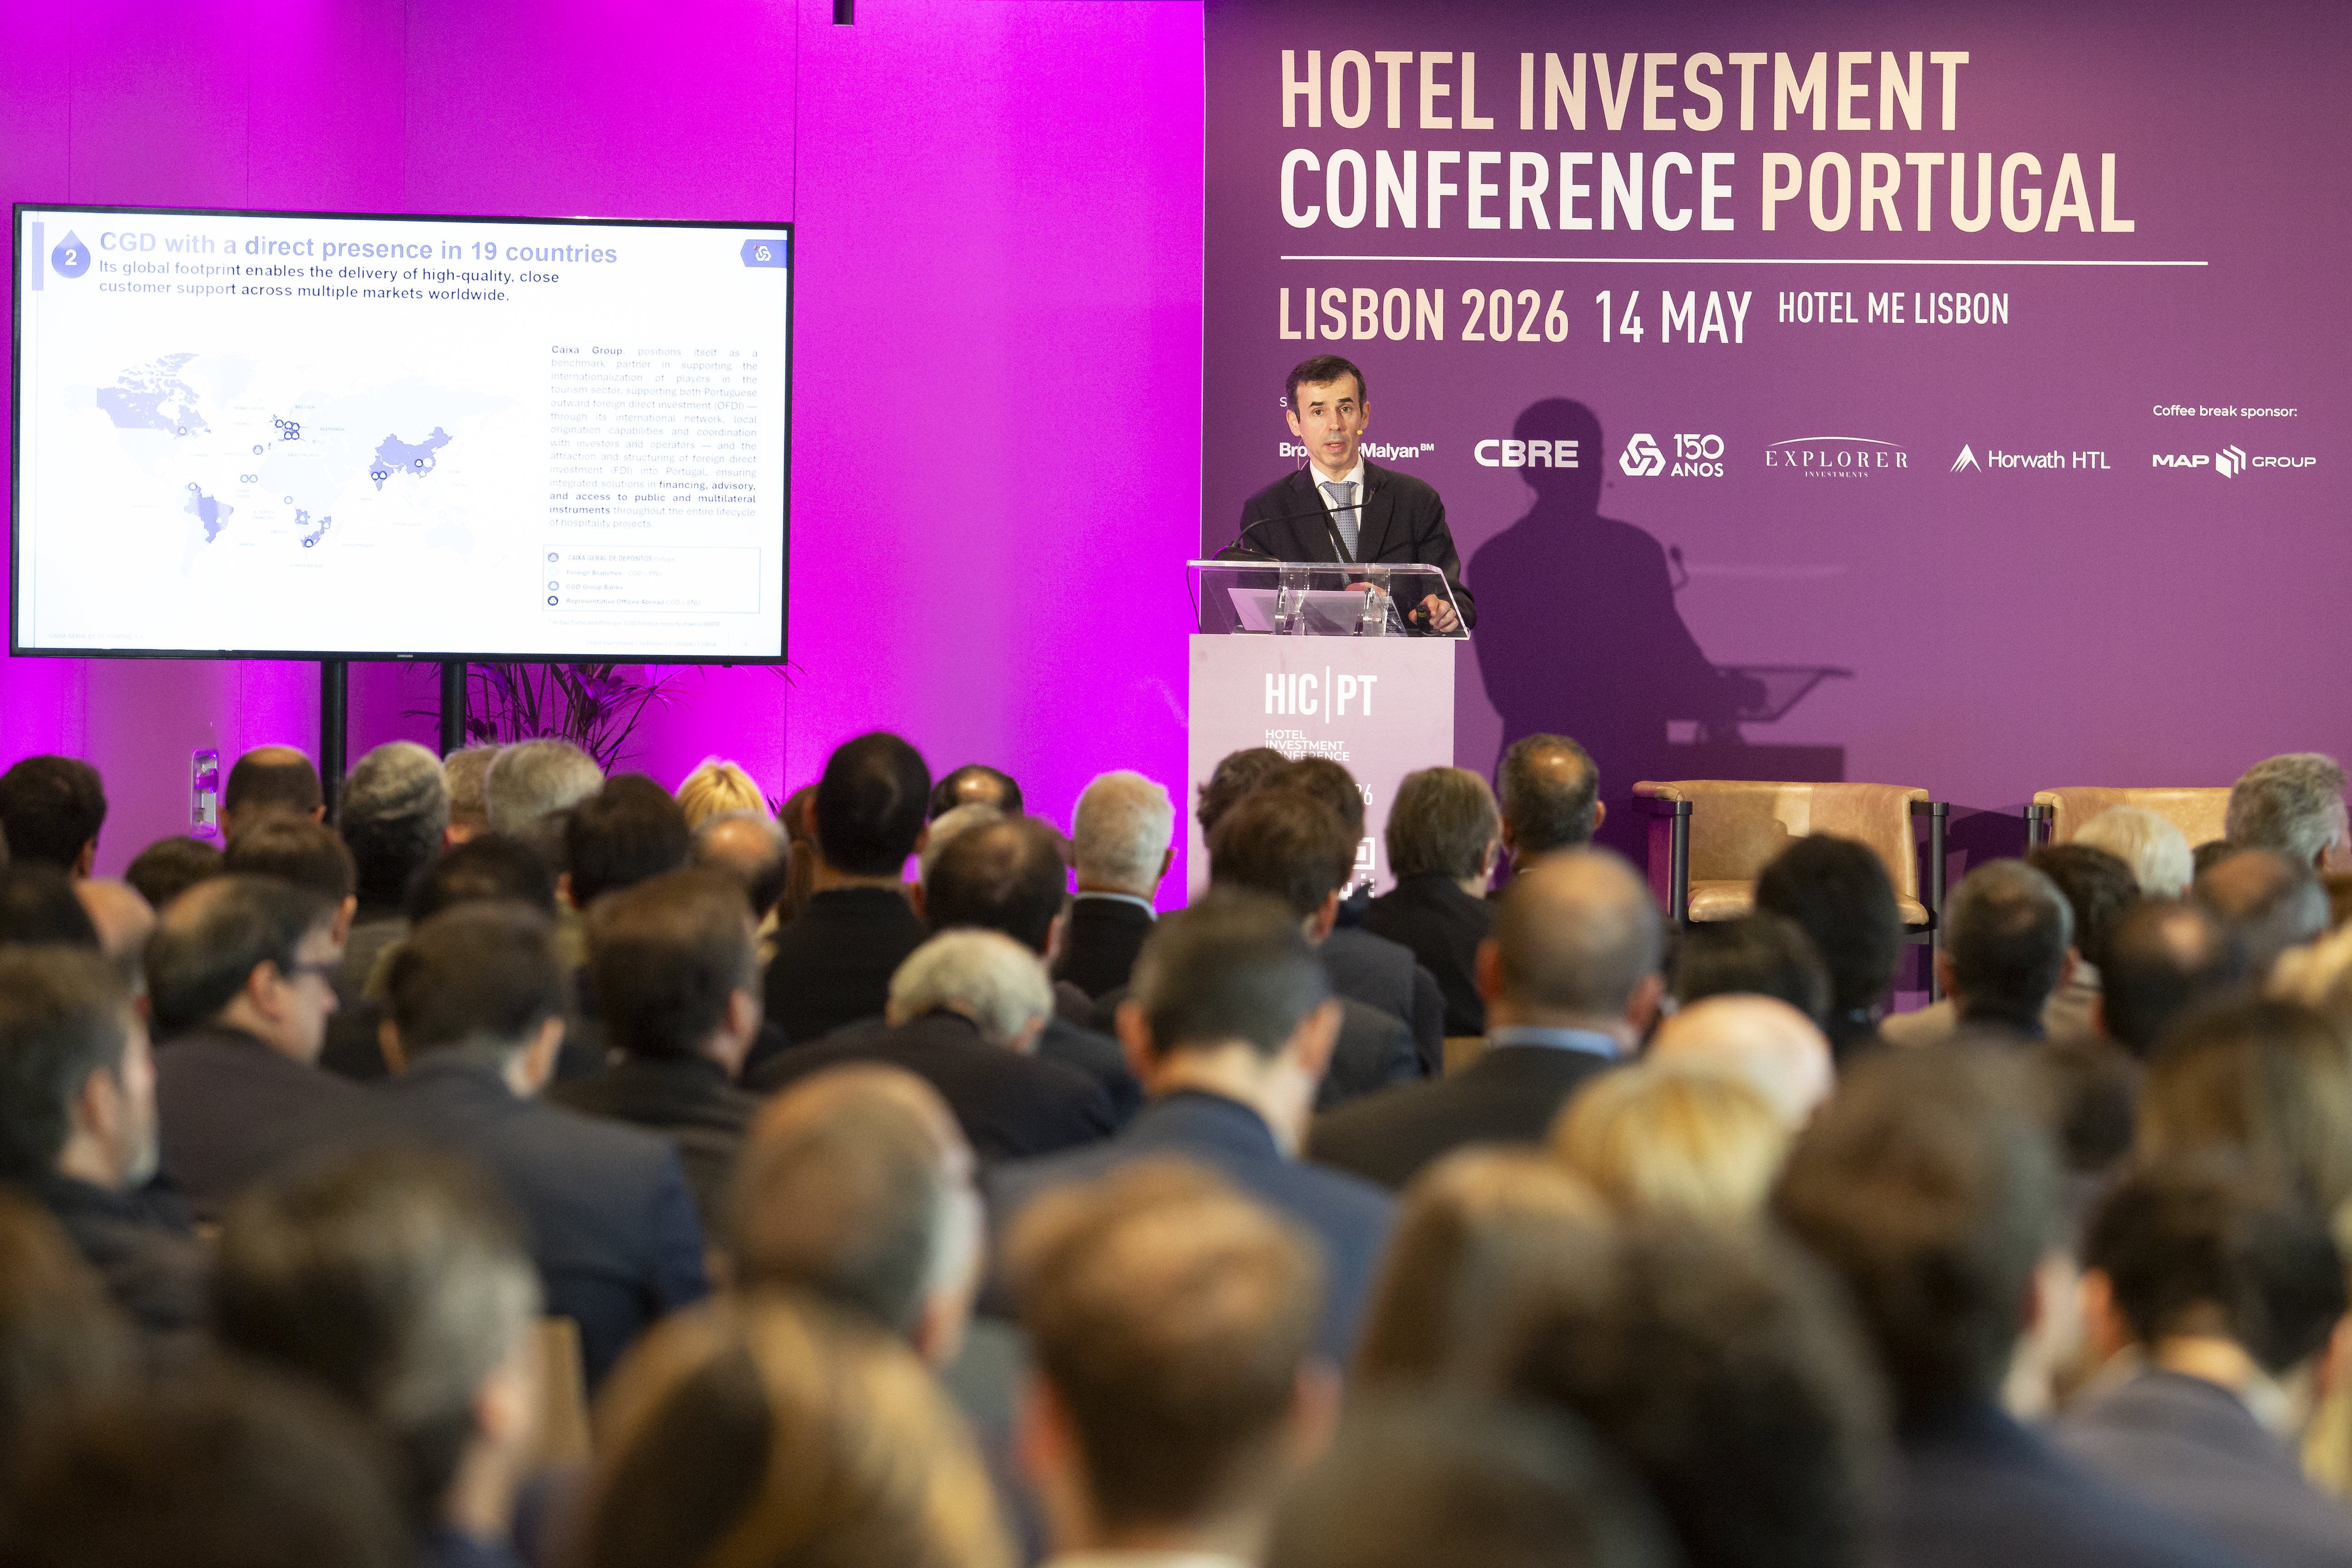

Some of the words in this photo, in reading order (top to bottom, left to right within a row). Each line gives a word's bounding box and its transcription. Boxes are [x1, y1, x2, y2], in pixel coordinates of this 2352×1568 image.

[1282, 50, 1493, 129] HOTEL
[1521, 51, 1969, 131] INVESTMENT
[1281, 149, 1735, 231] CONFERENCE
[1762, 152, 2134, 232] PORTUGAL
[100, 232, 156, 252] CGD
[164, 234, 215, 254] with
[224, 239, 237, 254] a
[245, 235, 314, 256] direct
[323, 242, 433, 261] presence
[441, 240, 462, 260] in
[471, 241, 497, 260] 19
[506, 243, 617, 263] countries
[65, 249, 77, 266] 2
[100, 260, 117, 272] Its
[123, 260, 169, 276] global
[175, 262, 241, 278] footprint
[246, 264, 305, 277] enables
[310, 265, 334, 278] the
[339, 266, 398, 282] delivery
[403, 268, 418, 280] of
[423, 268, 514, 285] high-quality,
[520, 270, 559, 283] close
[99, 281, 172, 293] customer
[177, 283, 237, 297] support
[242, 286, 292, 296] across
[298, 285, 359, 300] multiple
[363, 286, 423, 301] markets
[428, 288, 509, 301] worldwide.
[1780, 292, 1858, 323] HOTEL
[1869, 292, 1905, 323] ME
[1915, 293, 2008, 324] LISBON
[1280, 288, 1443, 340] LISBON
[1462, 289, 1568, 342] 2026
[1596, 291, 1644, 342] 14
[1662, 291, 1752, 343] MAY
[551, 345, 579, 354] Caixa
[638, 348, 681, 357] positions
[694, 348, 717, 357] itself
[552, 358, 605, 368] benchmark
[616, 360, 651, 369] partner
[681, 362, 732, 372] supporting
[551, 373, 643, 382] internationalization
[655, 374, 664, 382] of
[676, 374, 710, 384] players
[743, 375, 758, 384] the
[626, 388, 677, 397] supporting
[680, 387, 701, 396] both
[704, 388, 757, 398] Portuguese
[551, 399, 590, 408] outward
[593, 399, 625, 410] foreign
[628, 400, 656, 408] direct
[714, 402, 744, 412] (OFDI)
[2154, 405, 2195, 416] Coffee
[2200, 405, 2237, 416] break
[2241, 408, 2297, 419] sponsor:
[551, 412, 587, 422] through
[616, 414, 676, 422] international
[734, 415, 757, 424] local
[550, 426, 600, 435] origination
[609, 427, 664, 436] capabilities
[697, 428, 757, 437] coordination
[650, 441, 695, 450] operators
[741, 442, 756, 450] the
[1674, 434, 1724, 459] 150
[623, 454, 675, 464] structuring
[679, 454, 689, 462] of
[693, 454, 724, 464] foreign
[729, 454, 757, 463] direct
[1474, 440, 1578, 467] CBRE
[1766, 451, 1907, 467] EXPLORER
[1989, 450, 2064, 468] Horwath
[2073, 452, 2110, 469] HTL
[2153, 455, 2209, 467] MAP
[2252, 457, 2316, 467] GROUP
[611, 466, 633, 475] (FDI)
[640, 466, 658, 475] into
[716, 468, 757, 479] ensuring
[1671, 463, 1723, 477] ANOS
[550, 480, 597, 489] integrated
[601, 480, 644, 488] solutions
[634, 493, 666, 503] public
[673, 493, 691, 502] and
[698, 494, 756, 503] multilateral
[549, 505, 610, 515] instruments
[613, 506, 666, 516] throughout
[717, 508, 756, 518] lifecycle
[549, 518, 559, 526] of
[561, 518, 611, 529] hospitality
[1266, 730, 1306, 739] HOTEL
[1266, 740, 1344, 751] INVESTMENT
